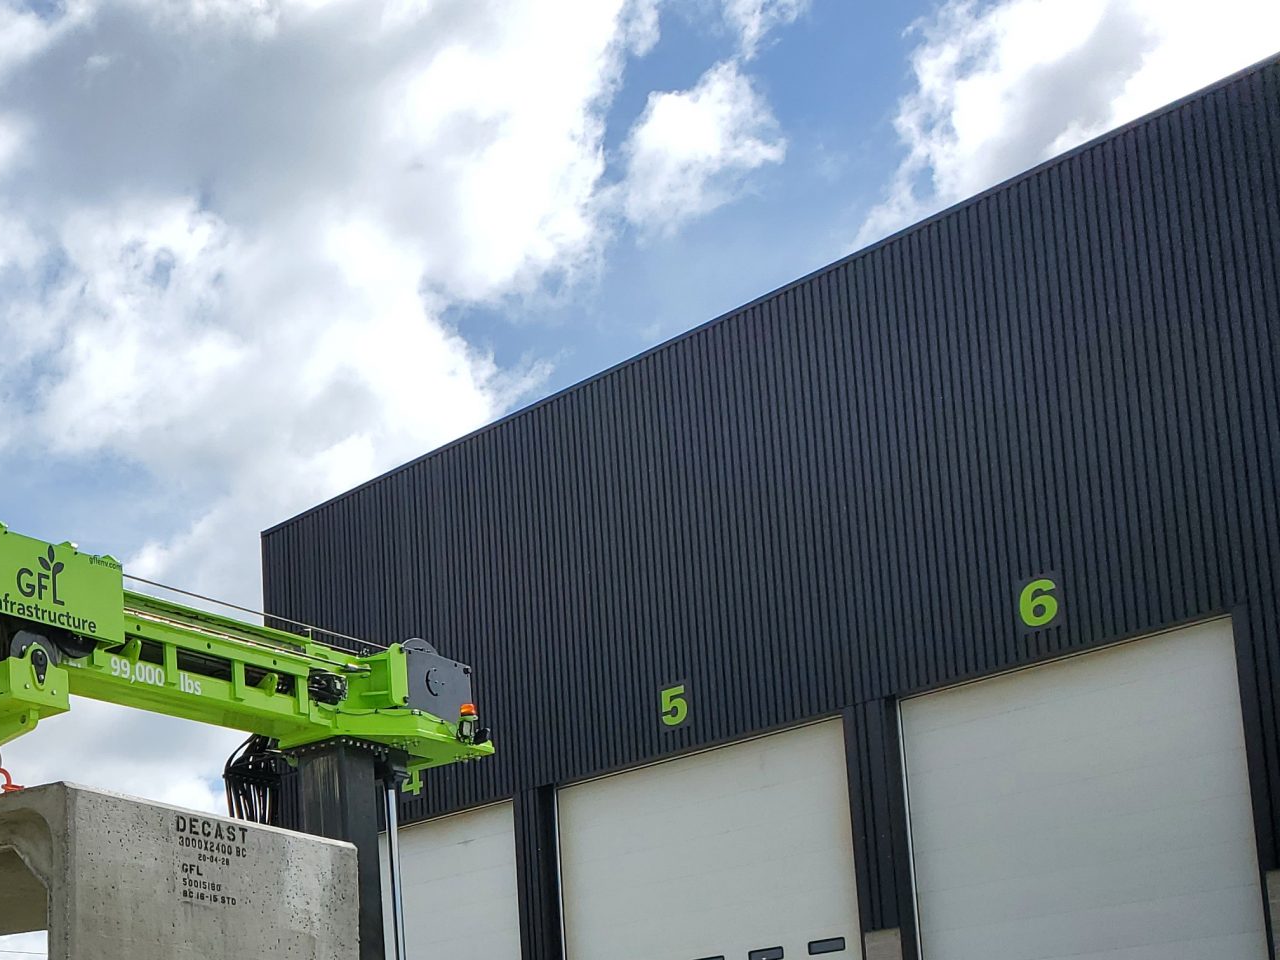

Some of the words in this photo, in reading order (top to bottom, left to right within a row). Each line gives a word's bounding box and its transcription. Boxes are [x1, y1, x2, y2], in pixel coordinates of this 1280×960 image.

[16, 558, 65, 606] GFL
[1019, 579, 1059, 627] 6
[111, 656, 166, 687] 99,000
[179, 672, 202, 696] lbs
[661, 685, 688, 726] 5
[401, 769, 424, 796] 4
[176, 815, 248, 844] DECAST
[178, 836, 233, 856] 3000X2400
[235, 846, 247, 858] BC
[182, 863, 203, 876] GFL
[182, 890, 194, 899] BC
